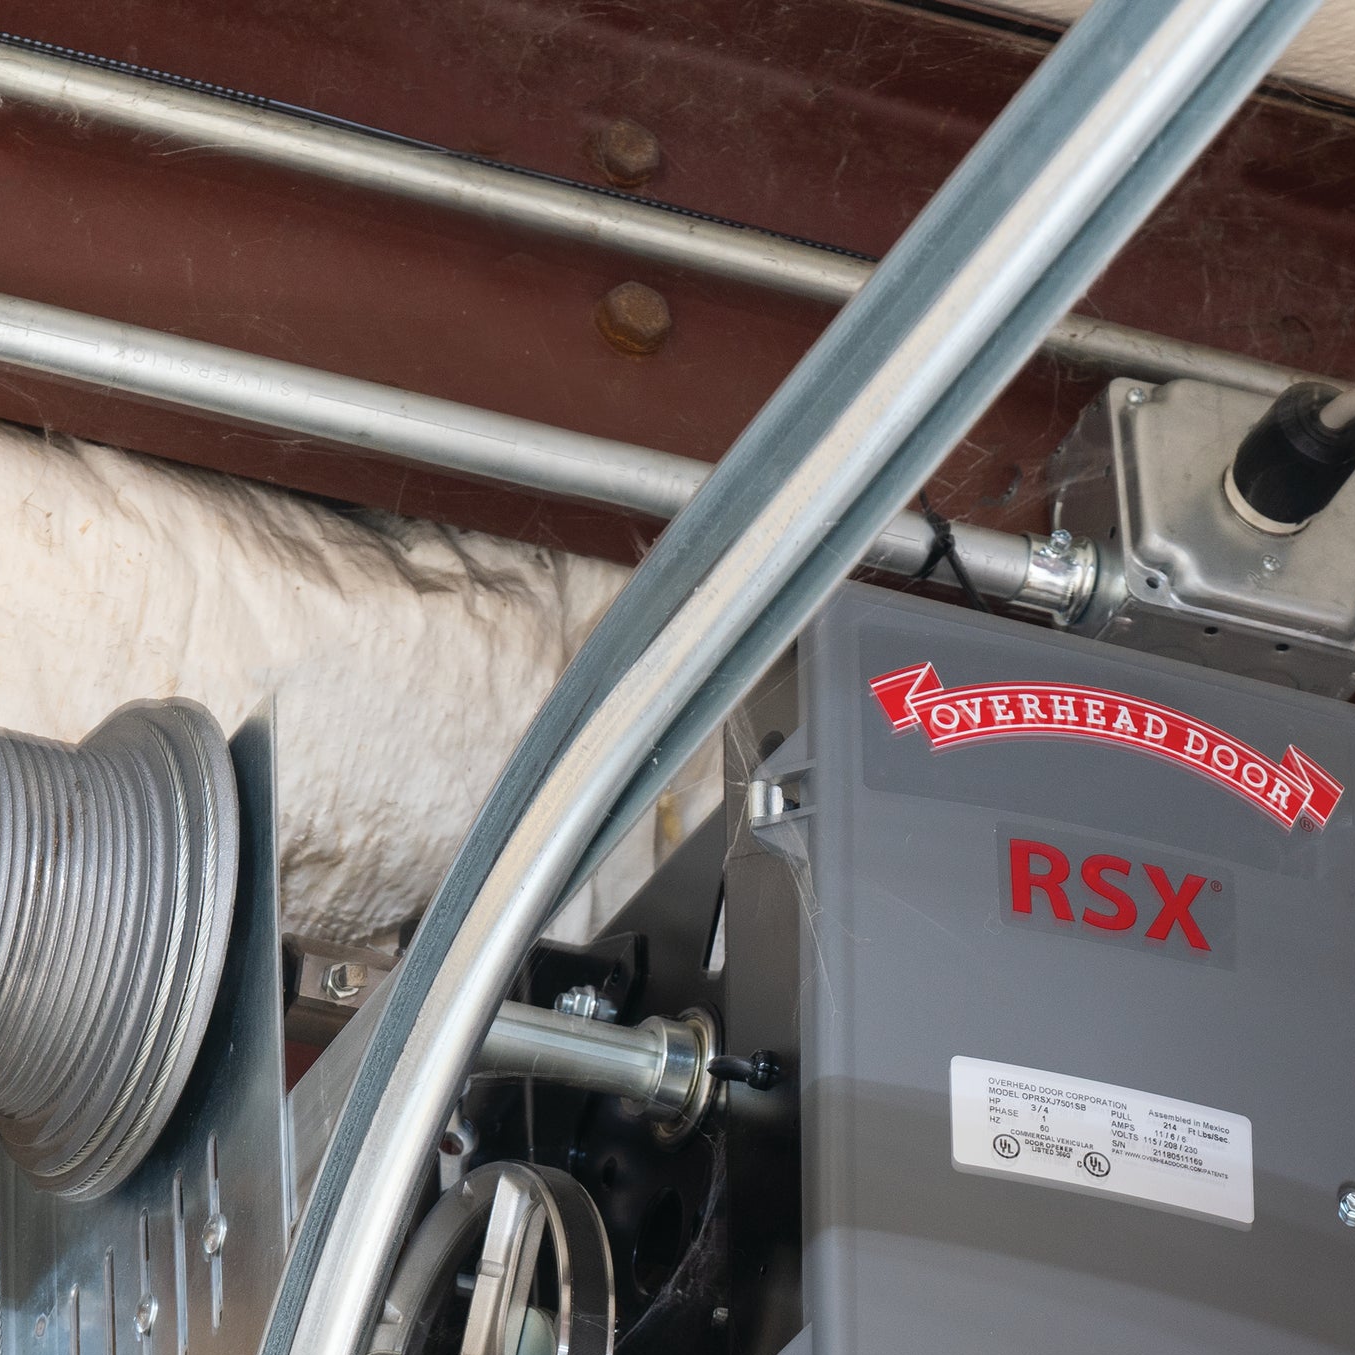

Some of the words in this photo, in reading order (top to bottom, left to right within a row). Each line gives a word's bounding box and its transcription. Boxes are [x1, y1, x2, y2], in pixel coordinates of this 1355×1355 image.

[930, 693, 1168, 741] OVERHEAD
[1184, 728, 1293, 811] DOOR
[1008, 838, 1211, 953] RSX
[988, 1077, 1036, 1092] OVERHEAD
[1040, 1087, 1063, 1097] DOOR
[1066, 1091, 1127, 1110] CORPORATION
[989, 1087, 1019, 1098] MODEL
[989, 1106, 1018, 1117] PHASE
[1111, 1110, 1132, 1121] PULL
[1163, 1122, 1177, 1131] 214
[1111, 1120, 1135, 1132] AMPS
[1149, 1109, 1191, 1125] Assembled
[1194, 1119, 1201, 1127] in
[1203, 1122, 1230, 1134] Mexico
[1010, 1129, 1055, 1142] COMMERCIAL
[1057, 1137, 1094, 1150] VEHICULAR
[1111, 1130, 1139, 1141] VOLTS
[1025, 1139, 1044, 1148] DOOR
[1046, 1142, 1073, 1153] OPENER
[1032, 1146, 1054, 1156] LISTED
[1112, 1140, 1125, 1148] S/N
